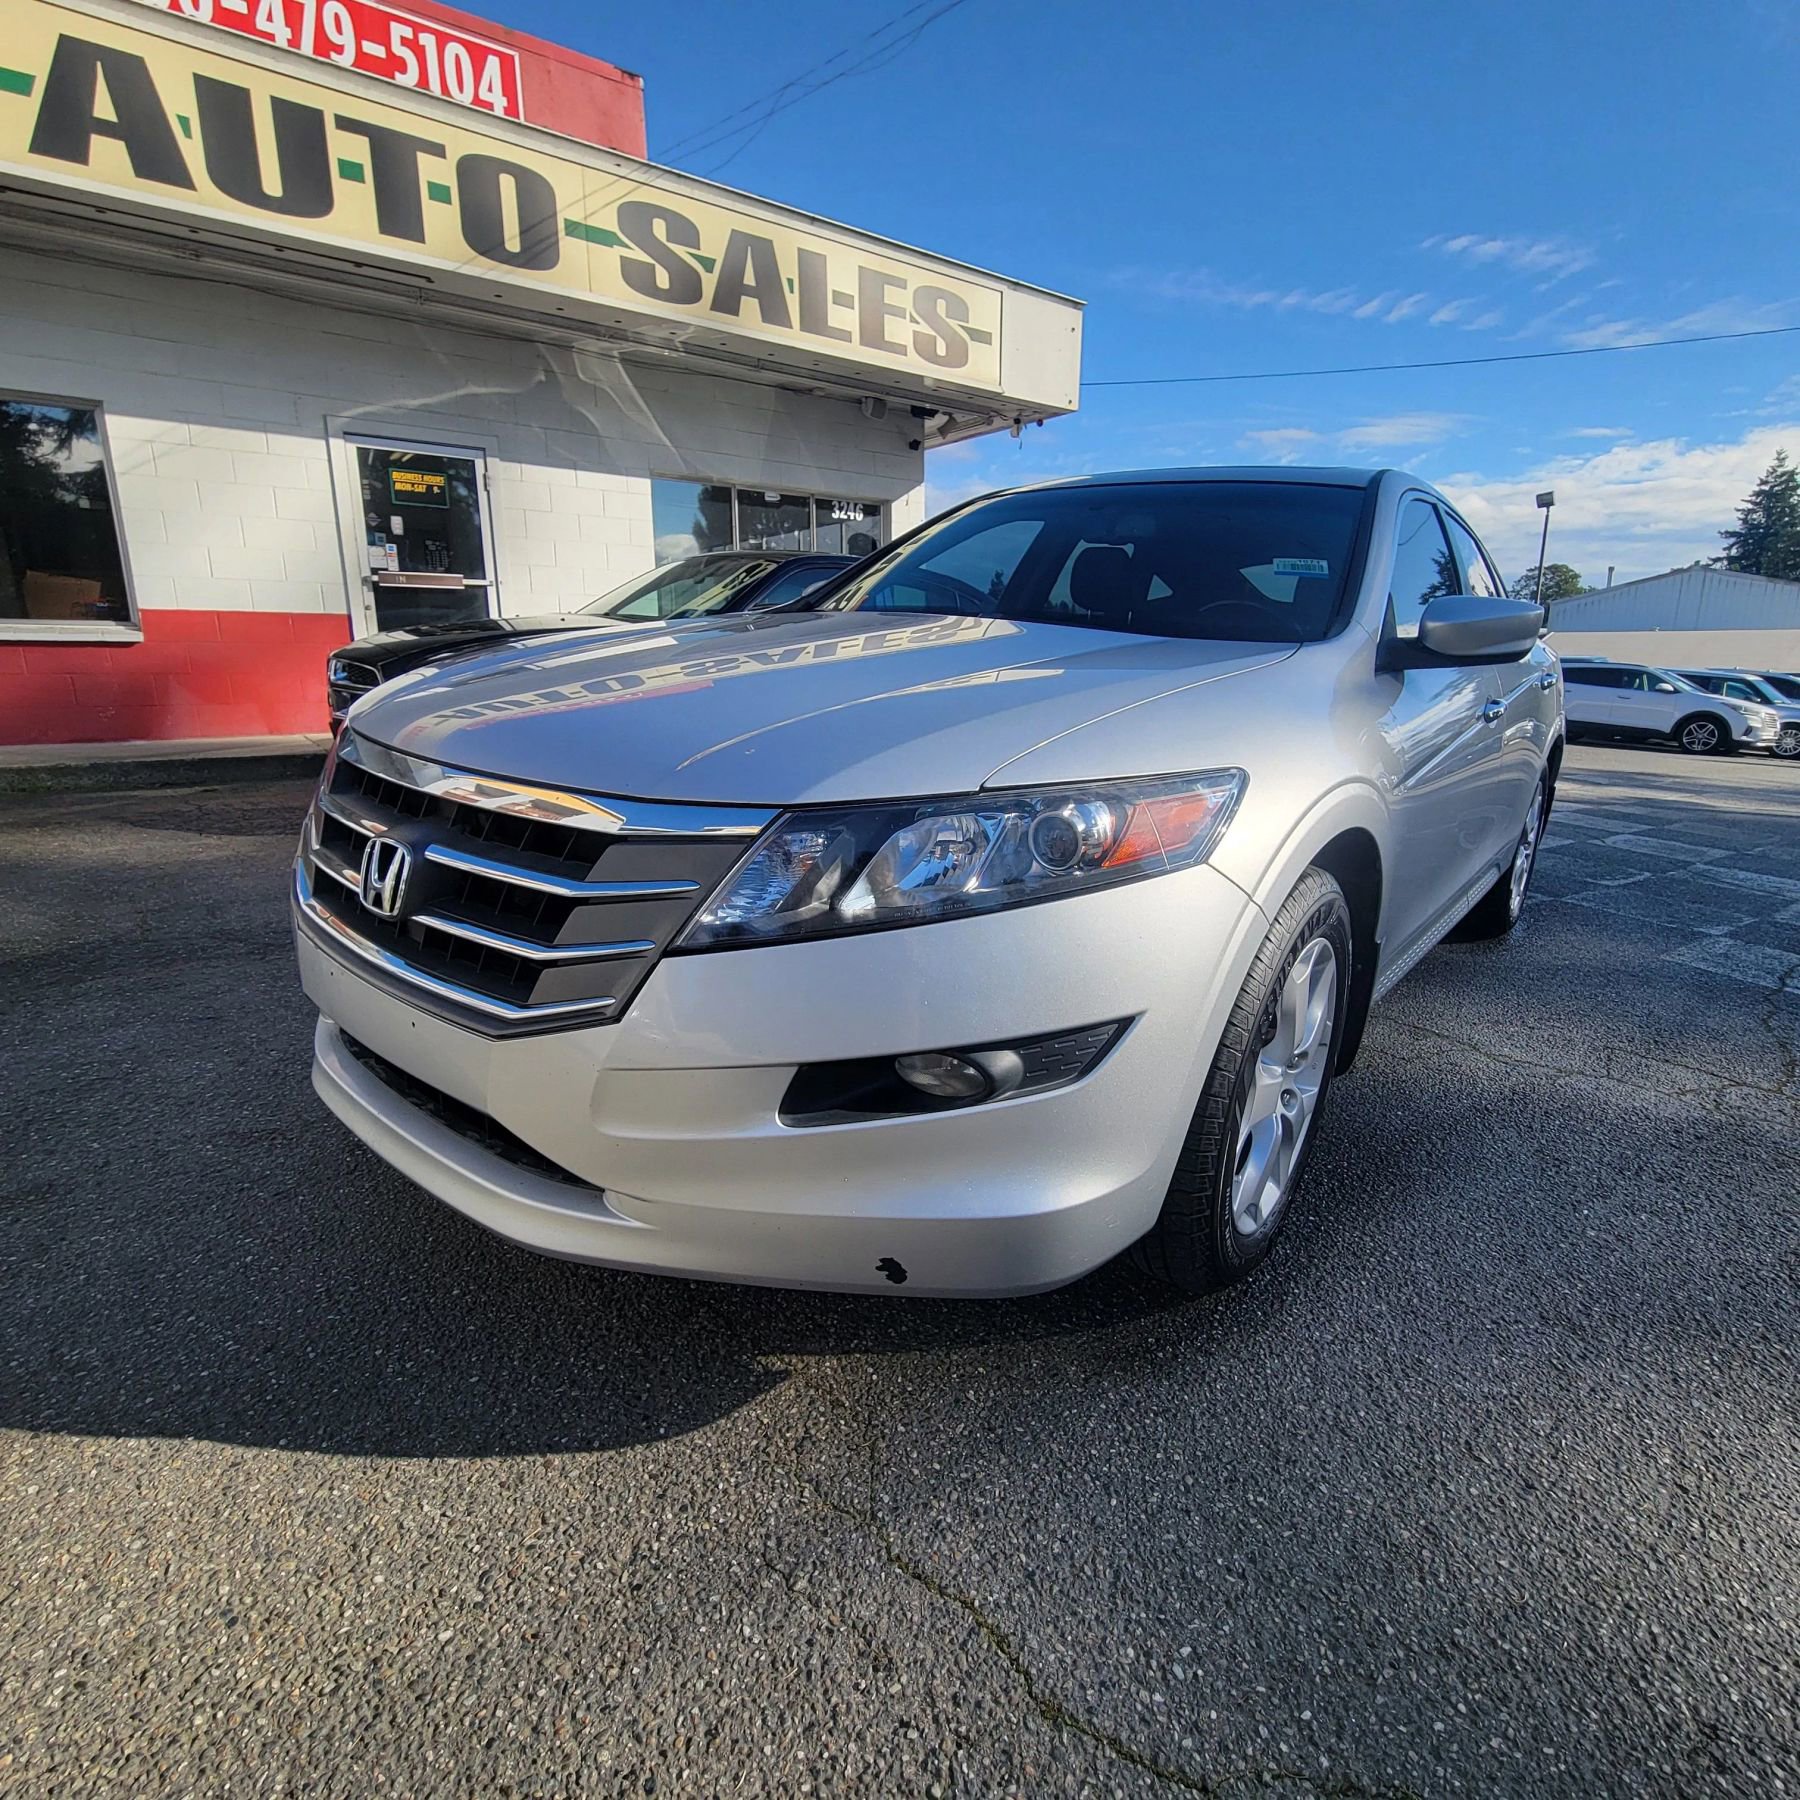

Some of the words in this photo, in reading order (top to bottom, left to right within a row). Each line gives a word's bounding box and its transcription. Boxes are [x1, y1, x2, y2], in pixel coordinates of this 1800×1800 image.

[29, 33, 560, 271] AUTO
[617, 200, 969, 369] SALES
[831, 500, 864, 521] 3246
